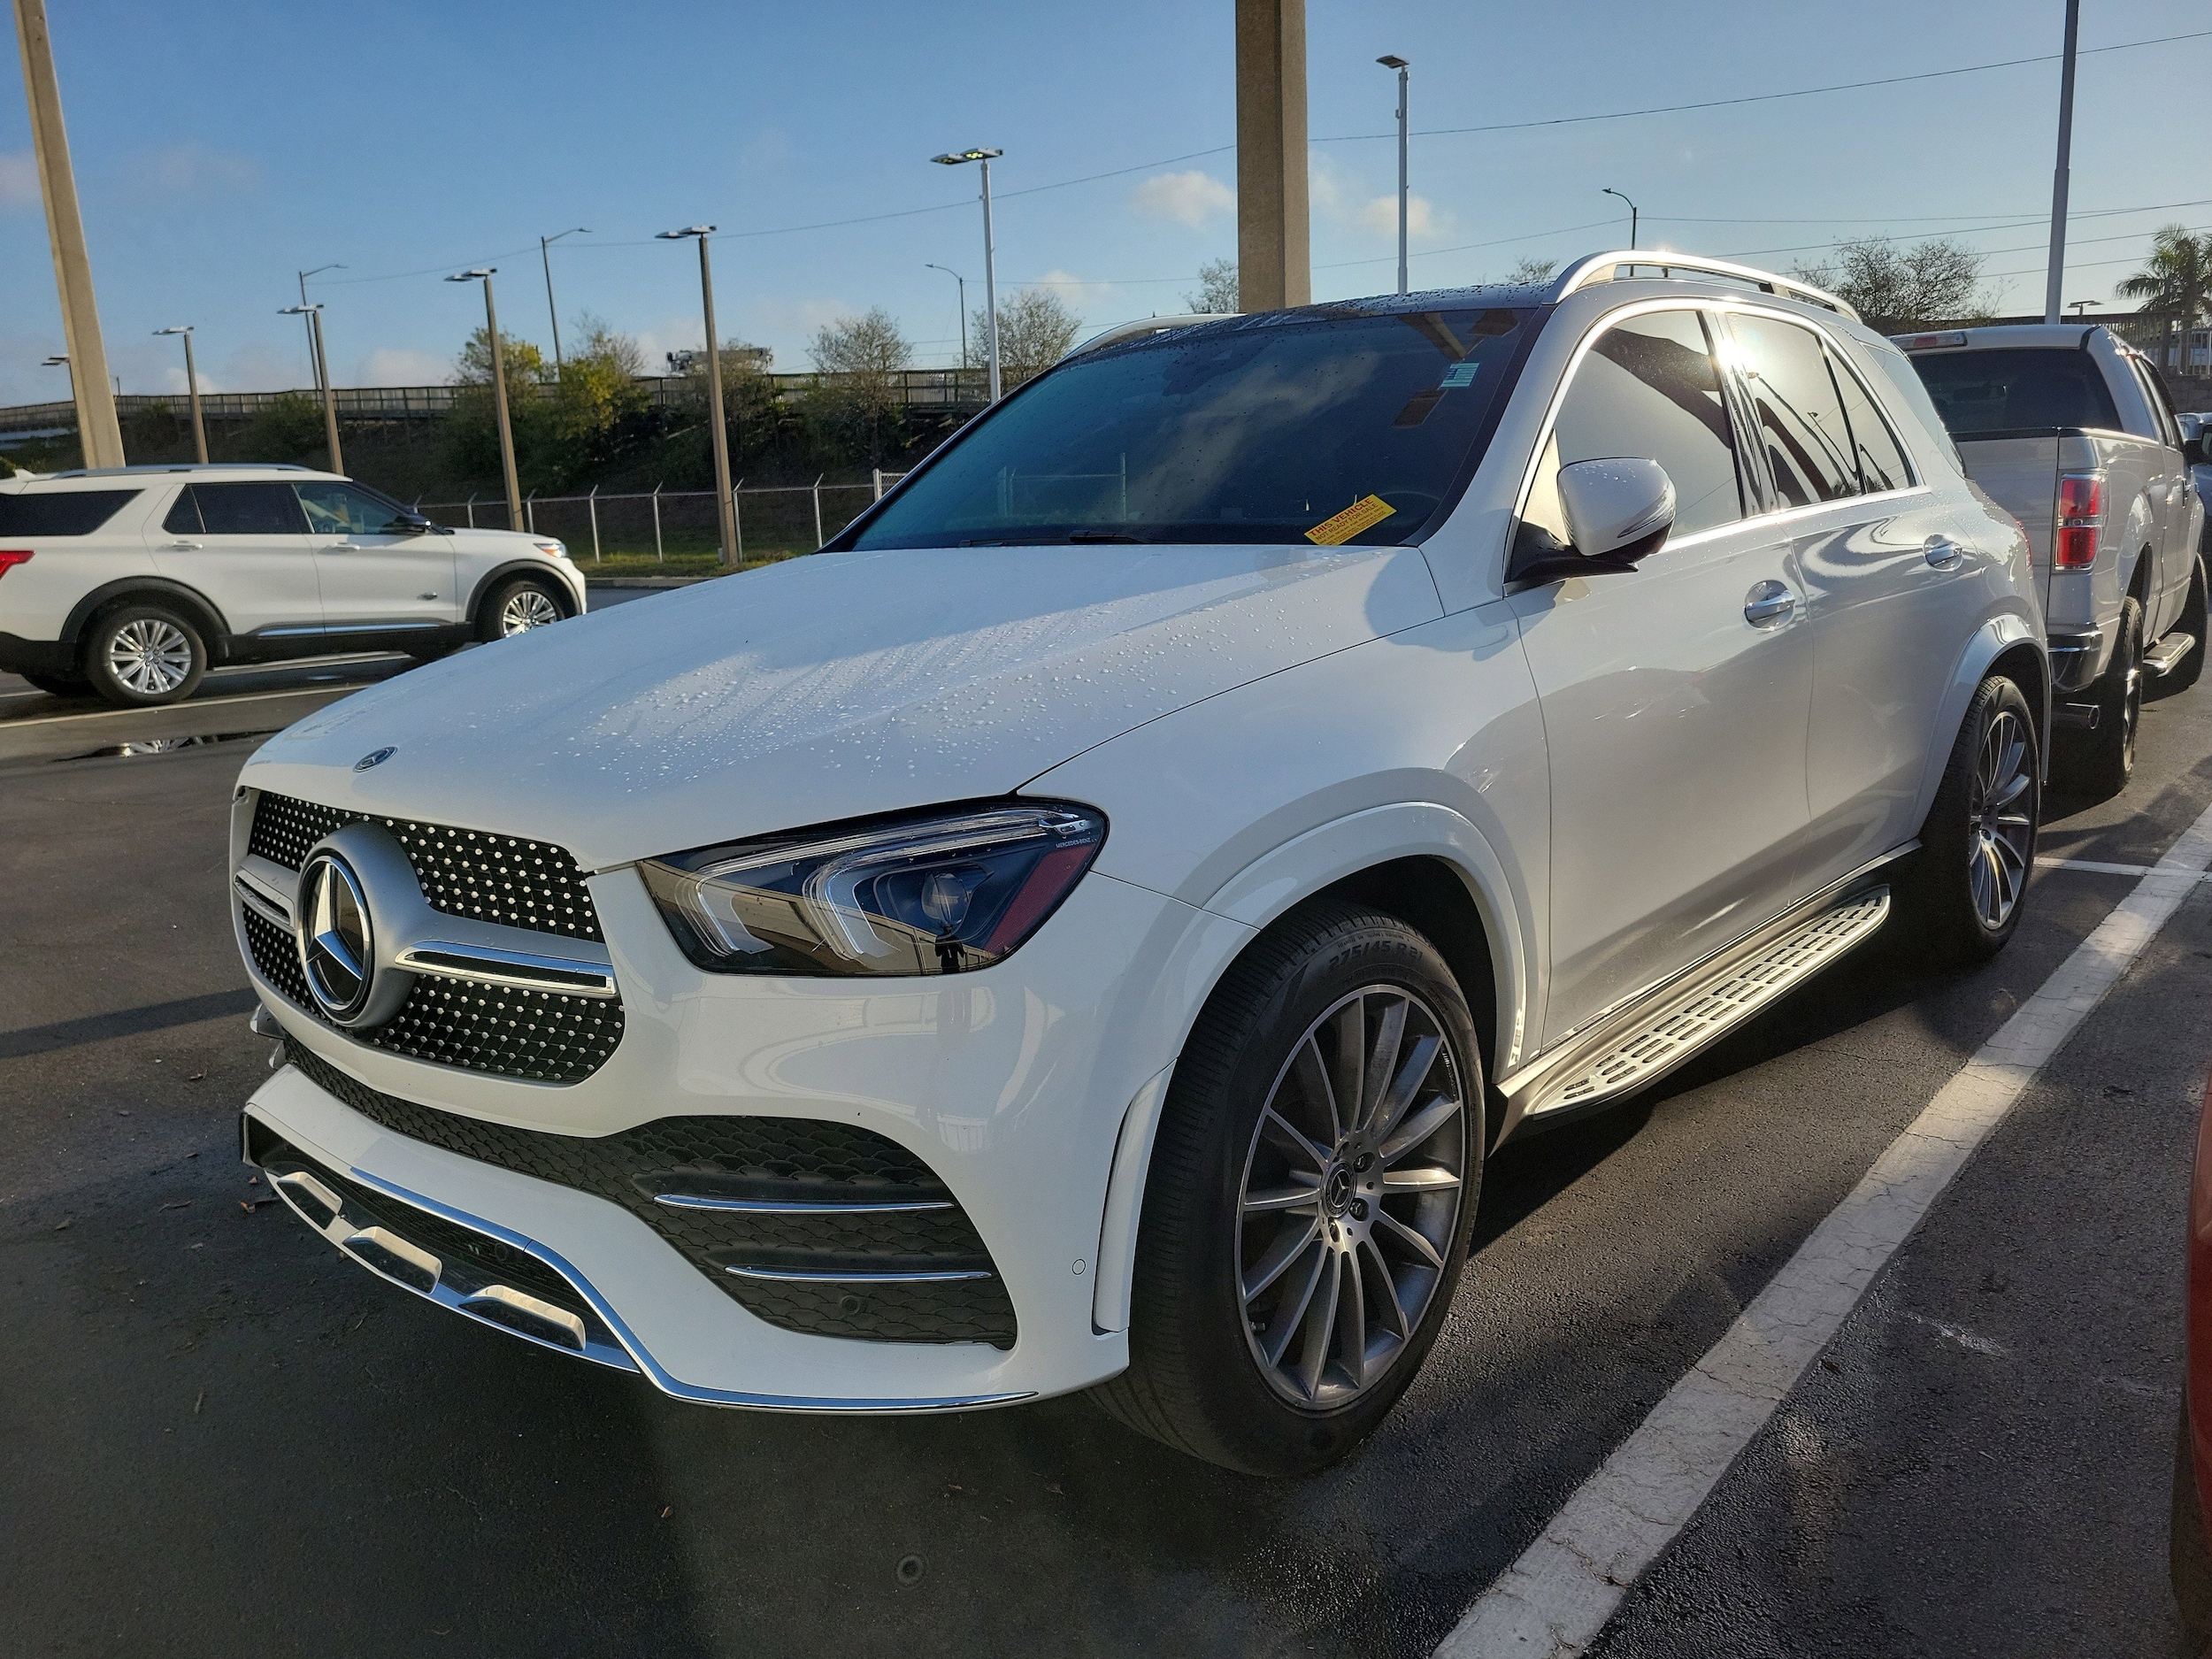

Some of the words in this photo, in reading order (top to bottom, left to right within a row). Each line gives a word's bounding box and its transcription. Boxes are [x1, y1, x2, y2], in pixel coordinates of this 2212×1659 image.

[1309, 521, 1333, 536] THIS
[1332, 498, 1373, 523] VEHICLE
[1316, 531, 1329, 541] NOT
[1329, 520, 1349, 534] READY
[1348, 512, 1361, 522] FOR
[1361, 503, 1378, 514] SALE
[1056, 837, 1091, 848] MERCEDES-BENZ
[1329, 940, 1391, 970] 275/45
